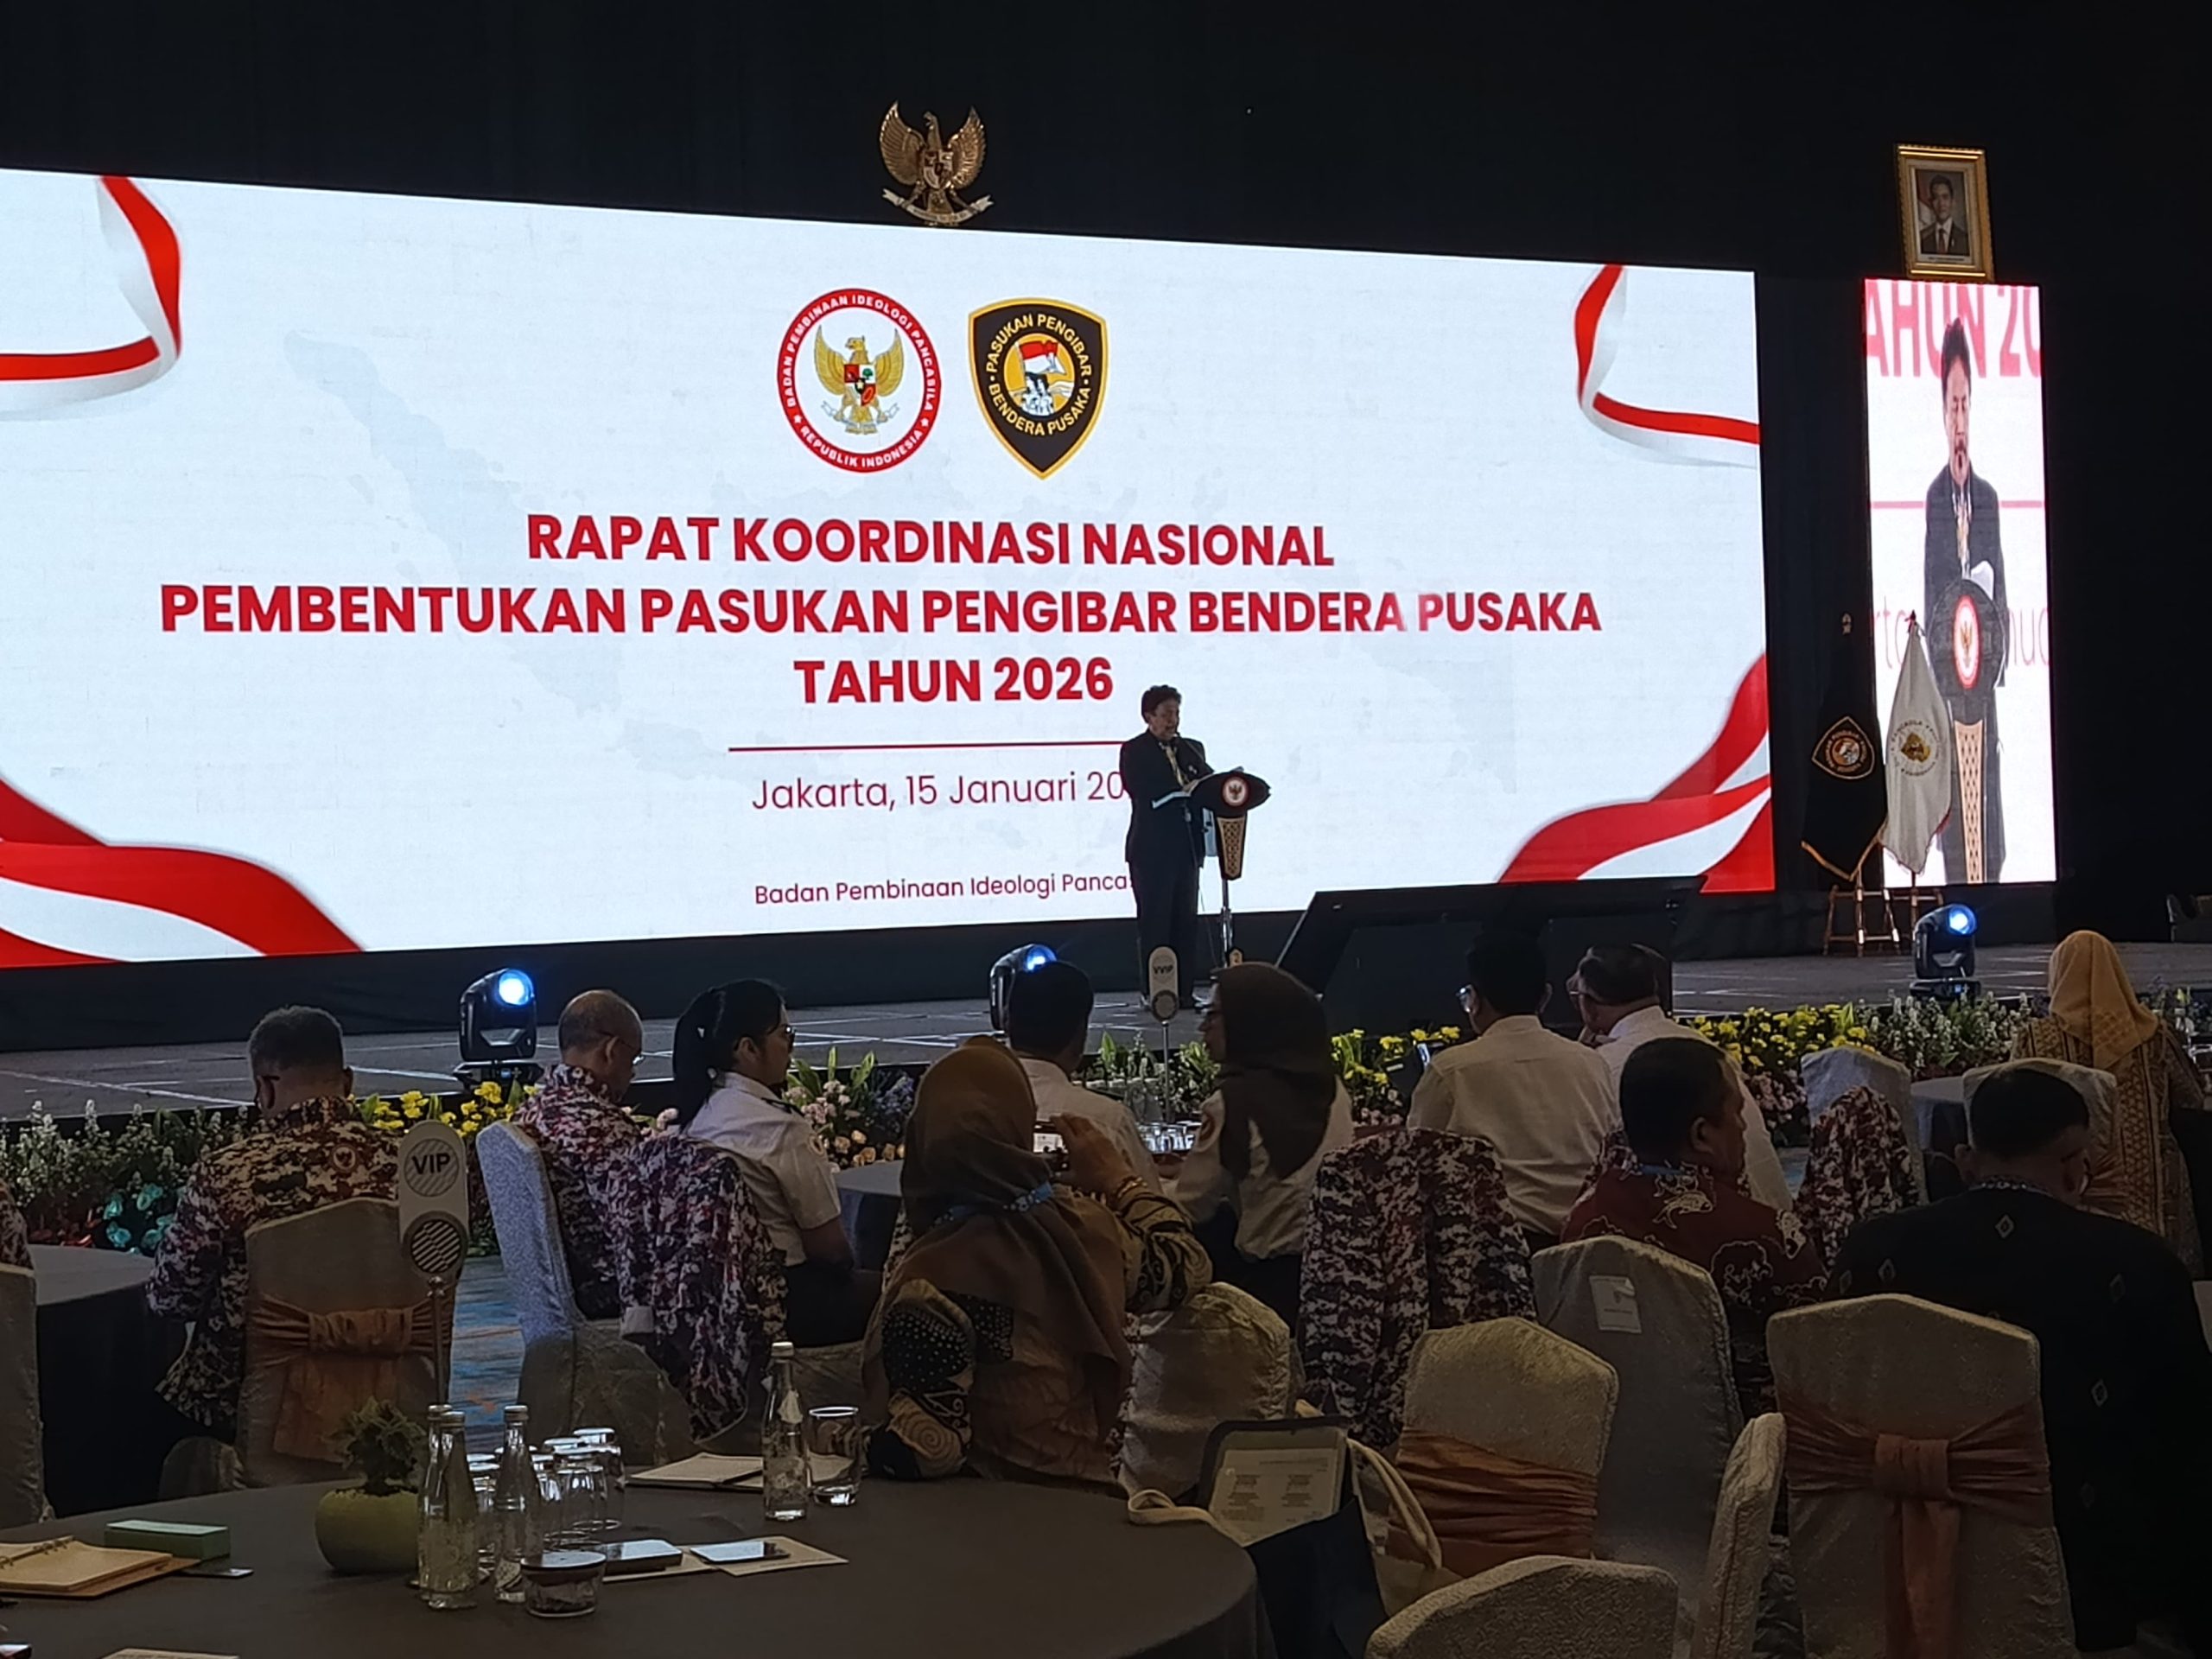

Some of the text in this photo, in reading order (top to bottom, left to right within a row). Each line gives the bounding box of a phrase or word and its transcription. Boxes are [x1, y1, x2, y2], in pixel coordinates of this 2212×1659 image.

[985, 313, 1093, 377] PASUKAN PENGIBAR
[1865, 279, 1986, 378] AHUN
[782, 294, 933, 412] BADAN PEMBINAAN IDEOLOGI PANCASILA
[988, 383, 1091, 436] BENDERA PUSAKA
[799, 425, 924, 468] REPUBLIK INDONESIA
[528, 515, 1334, 567] RAPAT KOORDINASI NASIONAL
[162, 585, 1602, 632] PEMBENTUKAN PASUKAN PENGIBAR BENDERA PUSAKA
[794, 658, 1113, 703] TAHUN 2026
[752, 771, 1124, 810] Jakarta, 15 Januari 20
[755, 873, 1133, 905] Badan Pembinaan Ideologi Panca
[411, 1152, 451, 1175] VIP
